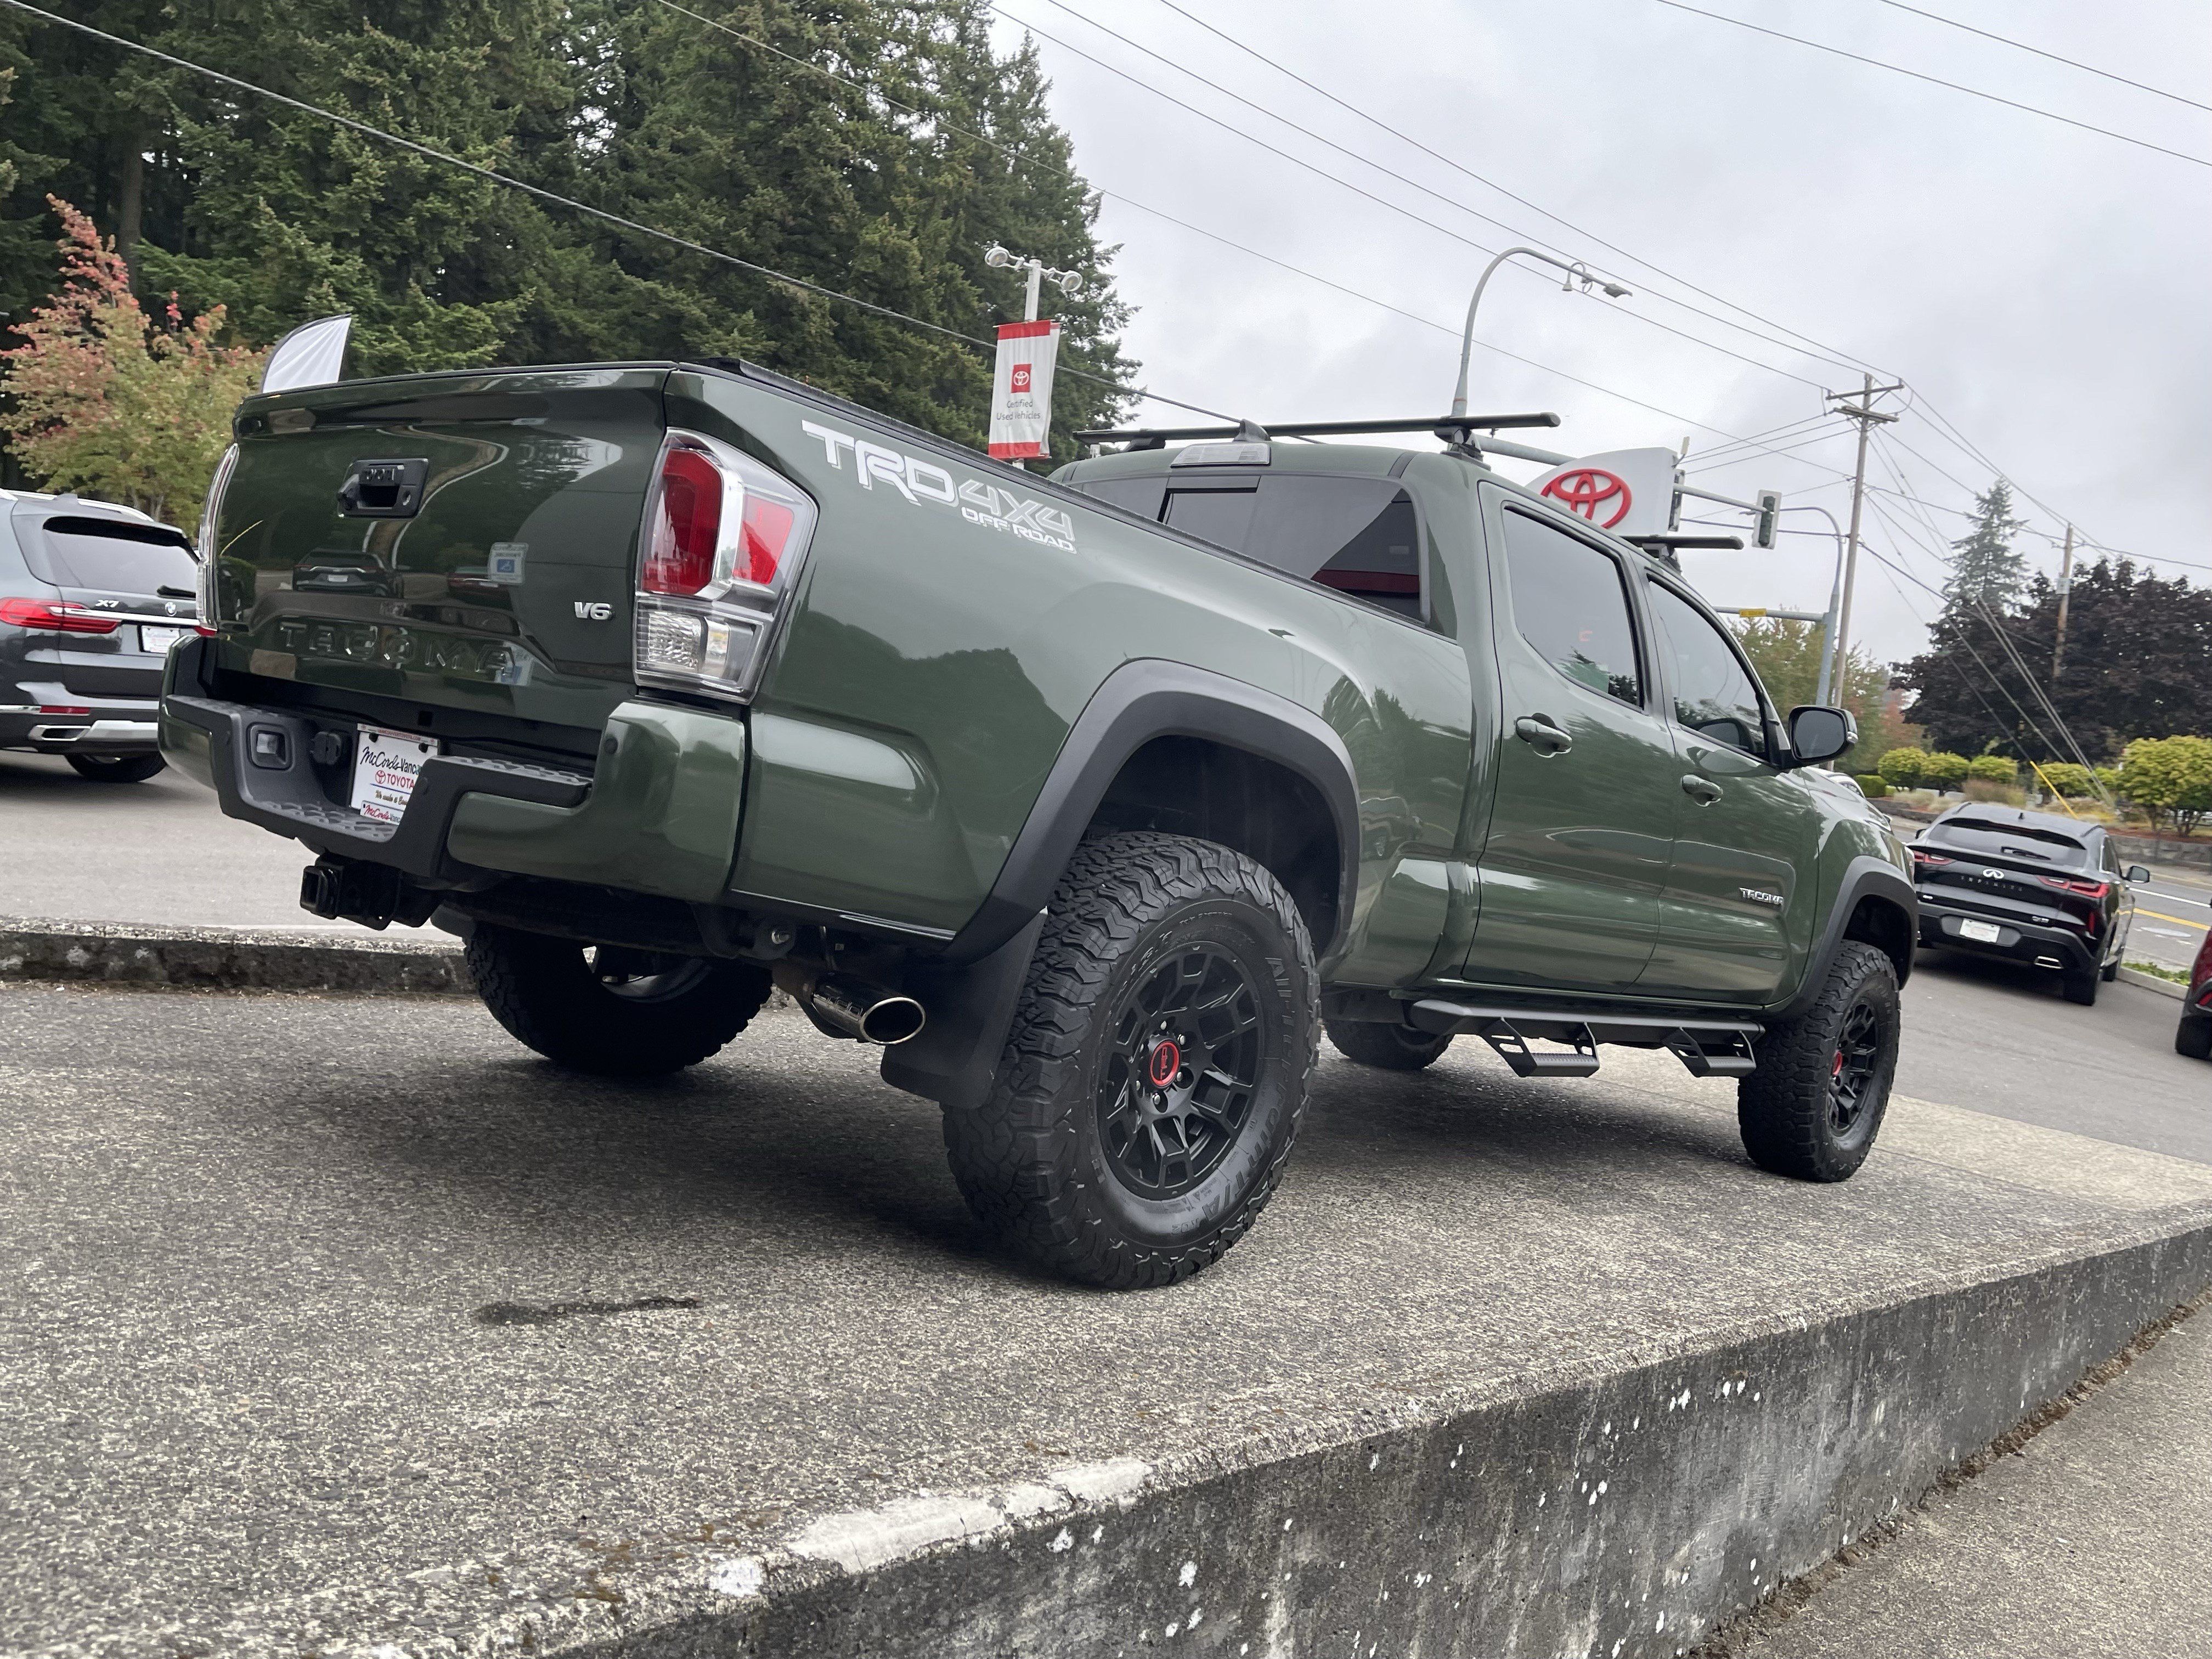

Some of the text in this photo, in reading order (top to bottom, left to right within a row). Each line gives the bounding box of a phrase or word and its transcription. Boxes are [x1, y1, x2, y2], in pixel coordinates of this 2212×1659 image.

[996, 412, 1013, 420] Used
[802, 420, 958, 506] TRD
[961, 506, 1077, 554] OFF ROAD
[95, 599, 120, 608] X7
[574, 601, 612, 620] V6
[387, 774, 414, 789] TOYOTA
